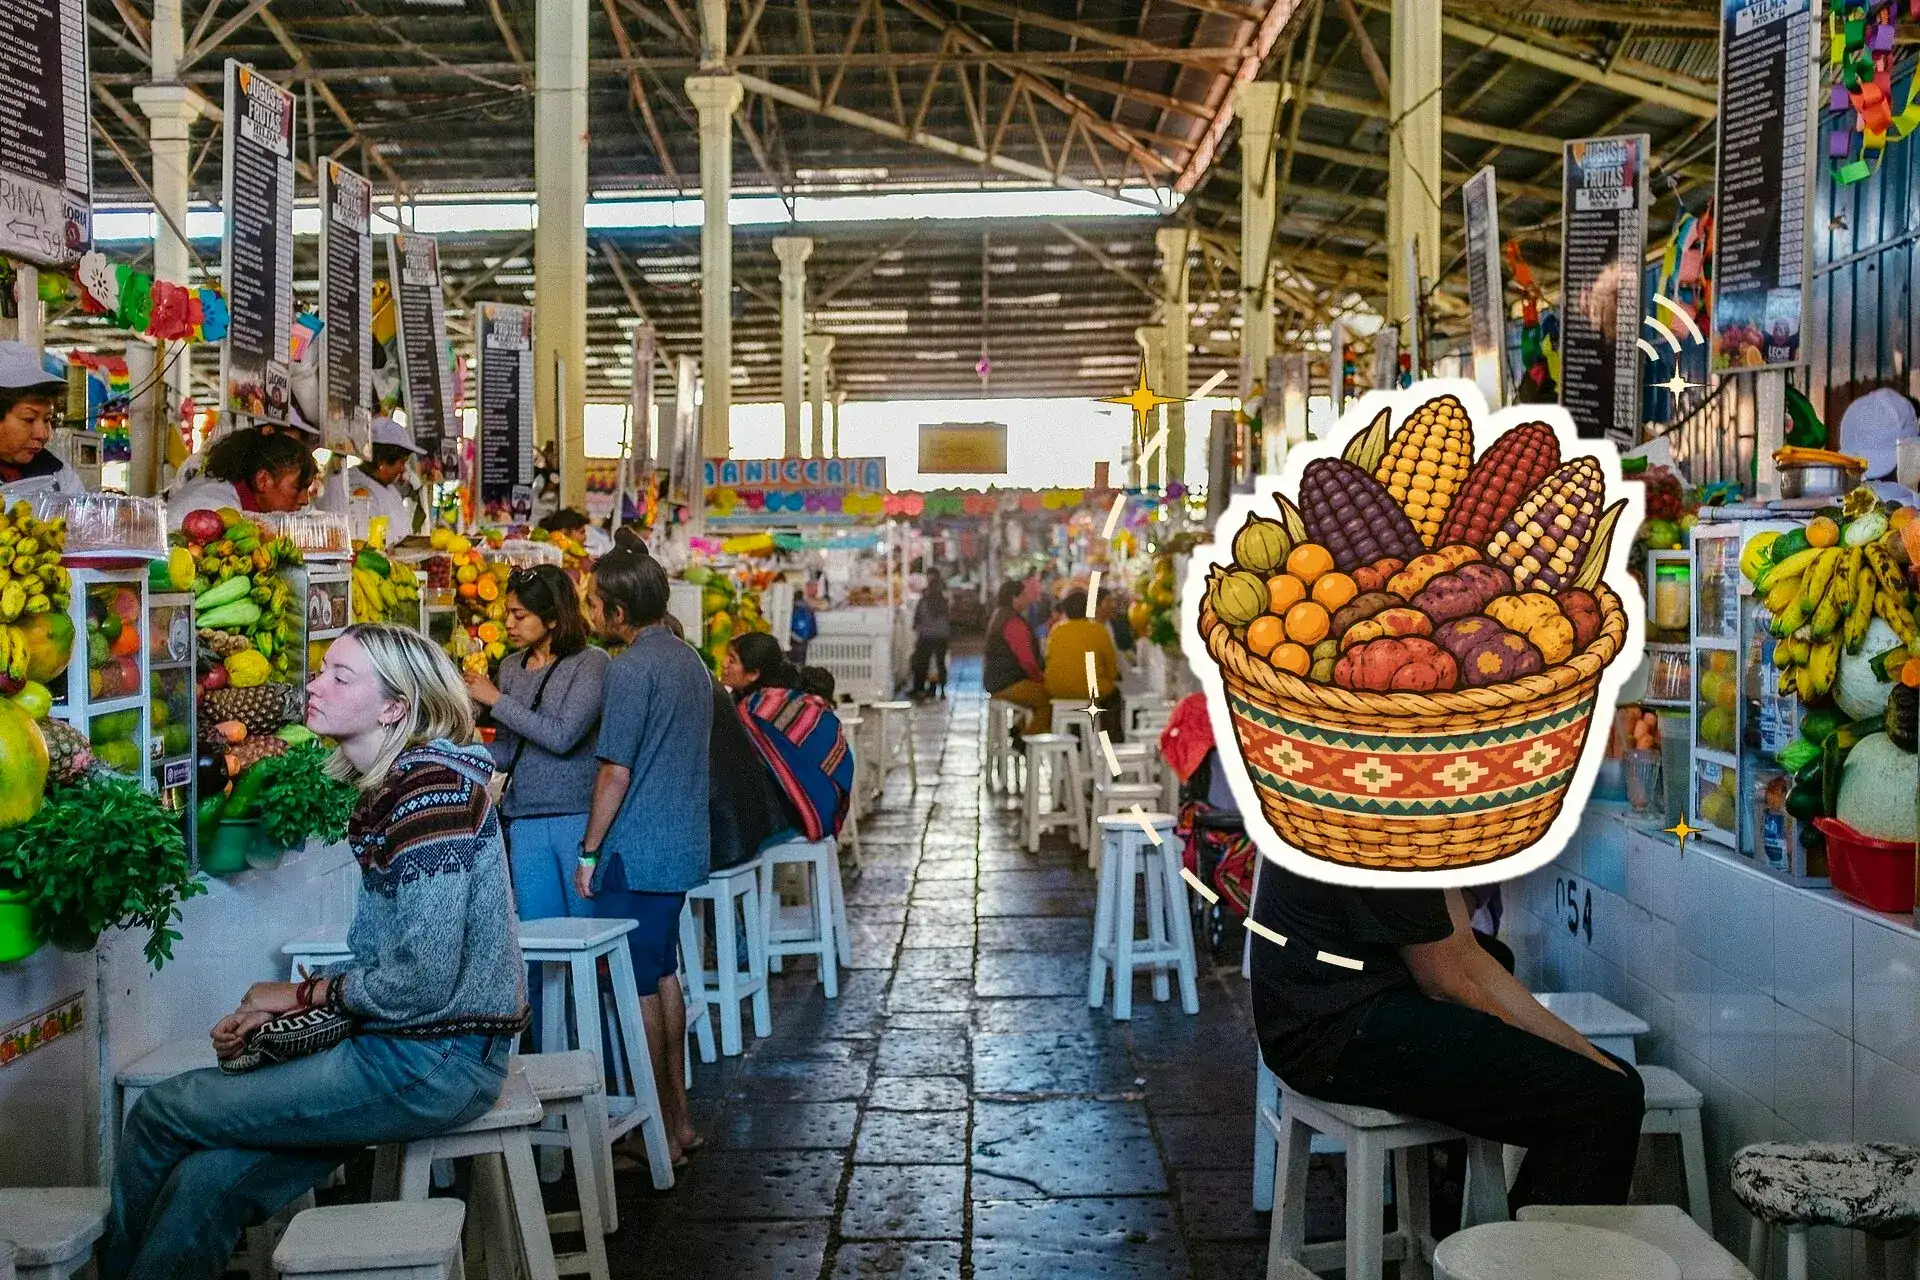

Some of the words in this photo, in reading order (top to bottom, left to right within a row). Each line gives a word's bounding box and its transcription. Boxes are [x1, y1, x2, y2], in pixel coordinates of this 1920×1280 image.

[14, 5, 23, 14] CON
[24, 10, 38, 22] LECHE
[28, 1, 53, 18] ZANAHORIA
[11, 14, 21, 24] CON
[22, 19, 35, 31] LECHE
[15, 37, 24, 46] CON
[25, 41, 38, 52] LECHE
[17, 49, 26, 58] CON
[27, 54, 41, 65] LECHE
[19, 60, 28, 69] CON
[29, 65, 43, 76] LECHE
[22, 81, 28, 90] DE
[248, 76, 276, 108] JUGOS
[23, 92, 29, 101] DE
[30, 95, 47, 107] FRUTAS
[0, 115, 17, 128] PEPINO
[18, 122, 27, 131] CON
[249, 99, 281, 134] FRUTAS
[1, 126, 20, 138] POMELO
[1, 137, 20, 150] PONCHE
[20, 144, 26, 152] DE
[27, 146, 46, 158] CERVEZA
[2, 148, 16, 159] MEDIO
[17, 153, 37, 166] ESPECIAL
[23, 166, 32, 174] CON
[33, 169, 48, 179] MALTA
[1584, 166, 1624, 188] FRUTAS
[1768, 346, 1790, 358] LECHE
